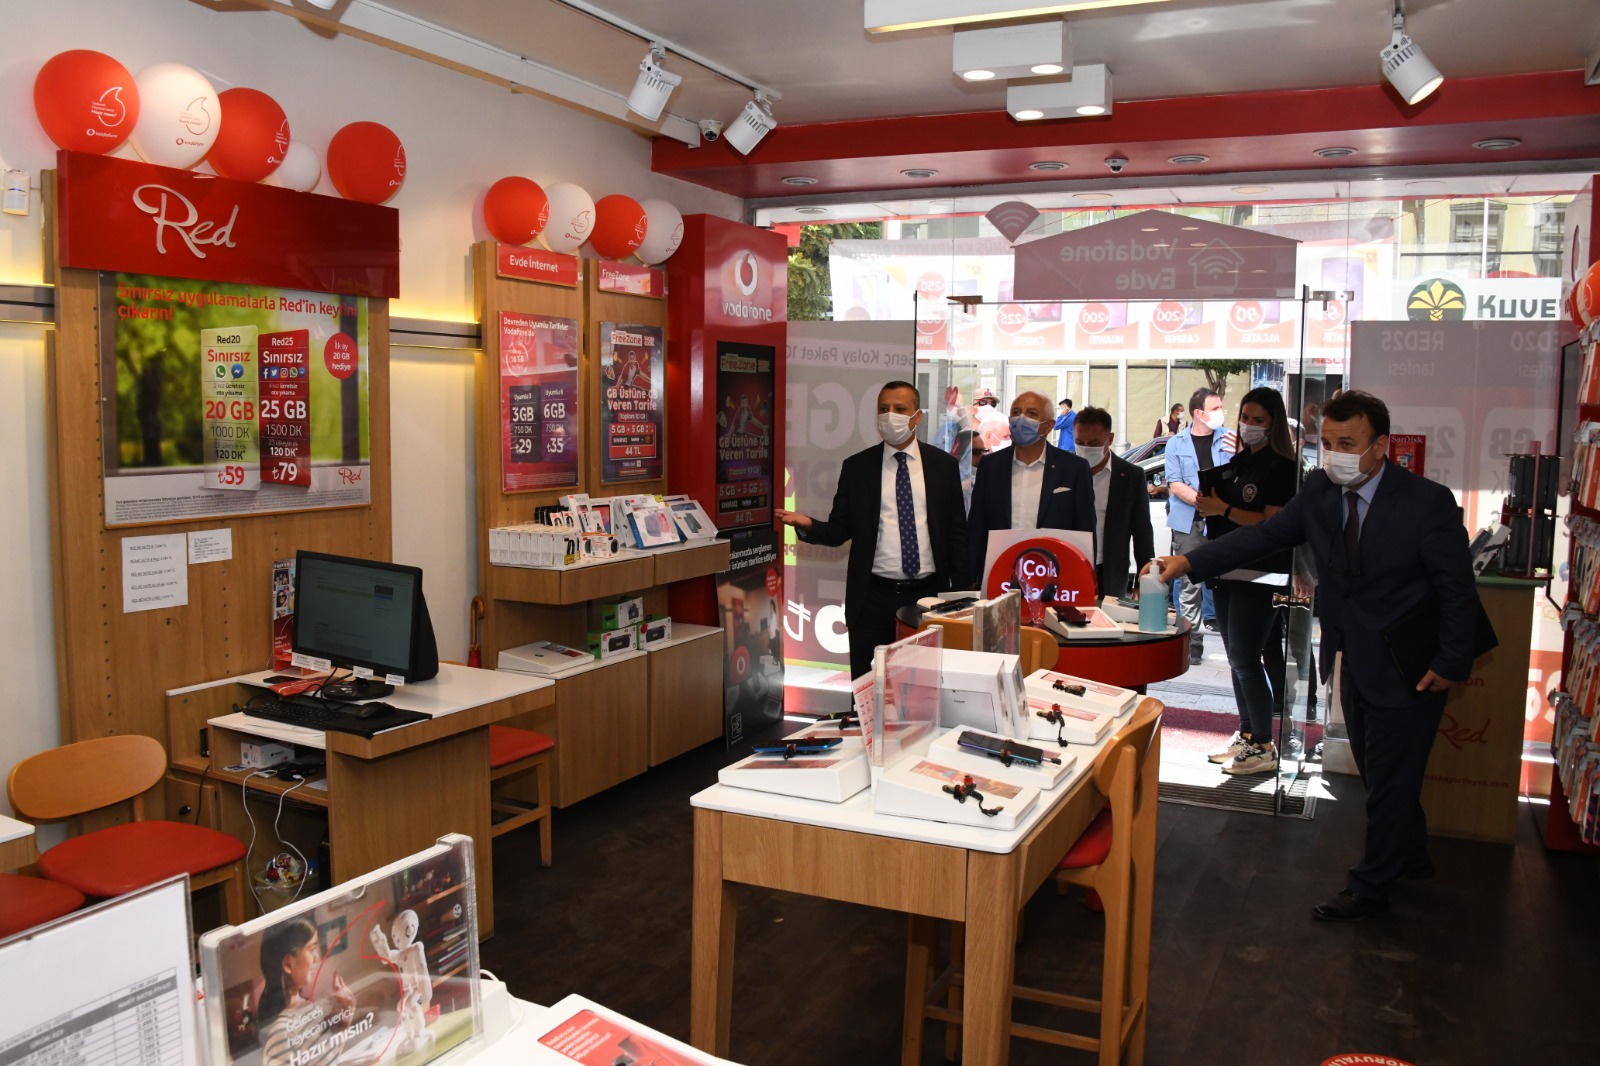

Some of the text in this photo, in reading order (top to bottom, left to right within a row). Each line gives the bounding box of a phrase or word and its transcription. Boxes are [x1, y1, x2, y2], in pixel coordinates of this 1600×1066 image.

[133, 183, 239, 259] Red
[509, 254, 559, 273] Evde İnternet
[602, 268, 630, 282] FreeZone
[117, 281, 174, 302] Sınırsız
[177, 289, 276, 311] uygulamalarla
[117, 304, 173, 321] çıkarın!
[722, 300, 772, 321] vodafone
[503, 317, 569, 331] Devreden Uyumlu Tarifeler
[216, 335, 241, 345] Red20
[271, 336, 294, 346] Red25
[611, 334, 642, 345] FreeZone
[207, 349, 251, 363] Sınırsız
[263, 350, 303, 363] Sınırsız
[332, 352, 350, 360] 20 GB
[331, 362, 351, 372] hediye
[721, 358, 756, 371] FreeZone
[606, 387, 618, 399] GB
[619, 385, 647, 399] Üstüne
[205, 400, 255, 420] 20 GB
[261, 400, 307, 419] 25 GB
[607, 399, 658, 411] Veren Tarife
[211, 425, 250, 438] 1000 DK
[266, 424, 302, 436] 1500 DK
[514, 425, 533, 434] 750 DK
[545, 423, 556, 432] 750
[611, 425, 616, 433] 5
[616, 425, 626, 433] GB
[631, 425, 636, 433] 5
[636, 425, 645, 433] GB
[718, 434, 770, 448] GB Üstüne GB
[1391, 435, 1424, 443] SanDisk
[215, 449, 230, 459] 120
[270, 446, 284, 456] 120
[625, 446, 642, 455] 44 TL
[719, 446, 769, 461] Veren Tarife
[338, 467, 362, 485] Red
[725, 485, 736, 496] GB
[743, 484, 748, 494] 5
[748, 483, 758, 494] GB
[745, 511, 753, 521] TL
[1022, 559, 1058, 579] Çok
[286, 1006, 324, 1032] Gelecek
[286, 1019, 327, 1048] heyecan
[289, 1011, 374, 1066] Hazır mısın?
